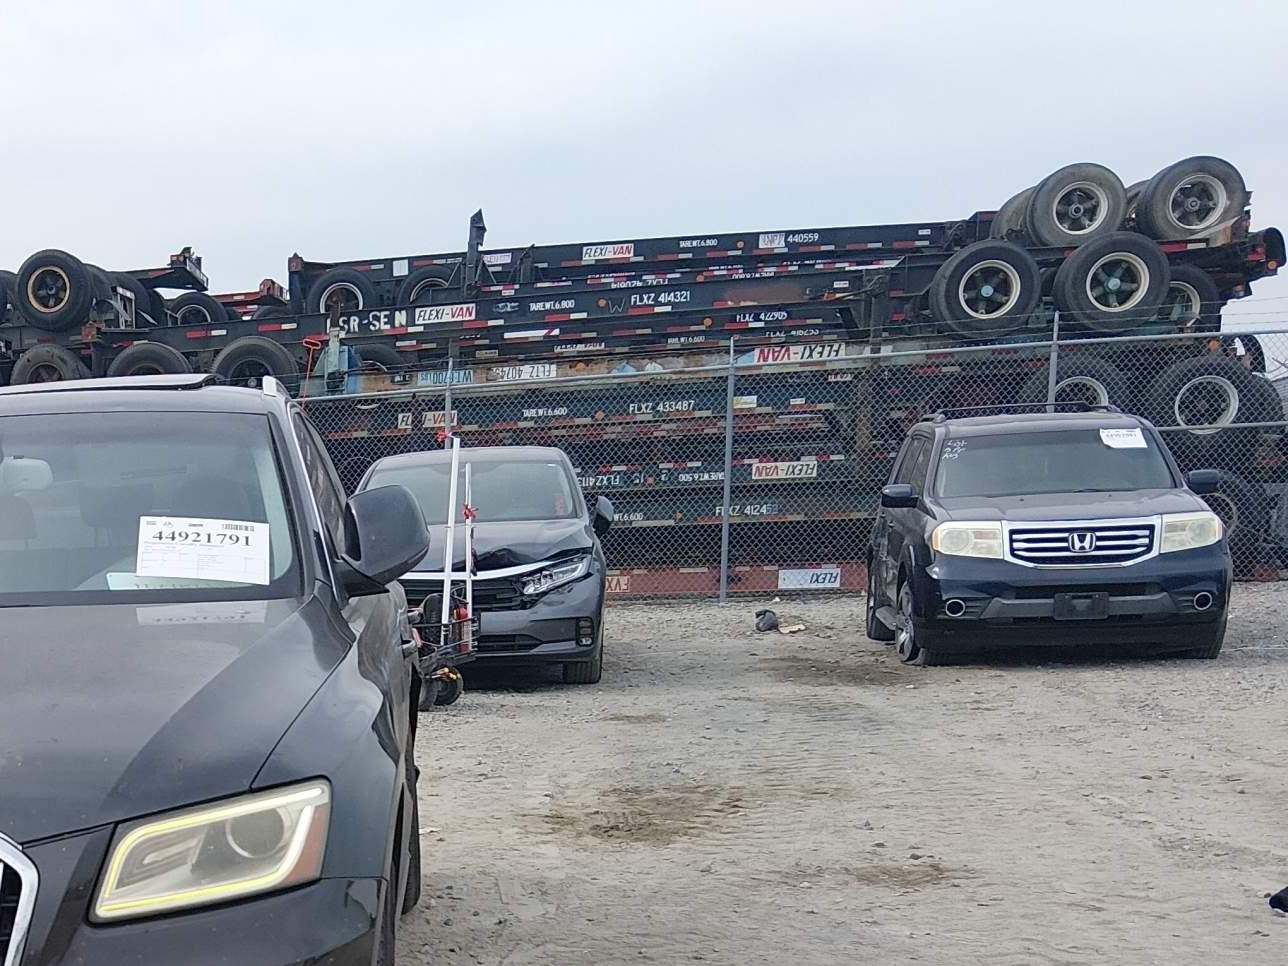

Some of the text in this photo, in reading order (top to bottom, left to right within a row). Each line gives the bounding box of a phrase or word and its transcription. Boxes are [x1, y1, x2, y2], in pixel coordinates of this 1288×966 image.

[787, 232, 820, 243] 440559
[584, 245, 633, 259] FLEXI-VAN
[630, 291, 691, 305] FLXZ 414321
[416, 306, 474, 321] FLEXI-VAN
[756, 344, 842, 363] FLEXI-VAN
[629, 400, 695, 415] FLXZ 433487
[753, 461, 817, 477] FLEXI-VAN
[152, 530, 251, 547] 44921791
[605, 576, 630, 591] FVX
[809, 569, 840, 584] FLEXI
